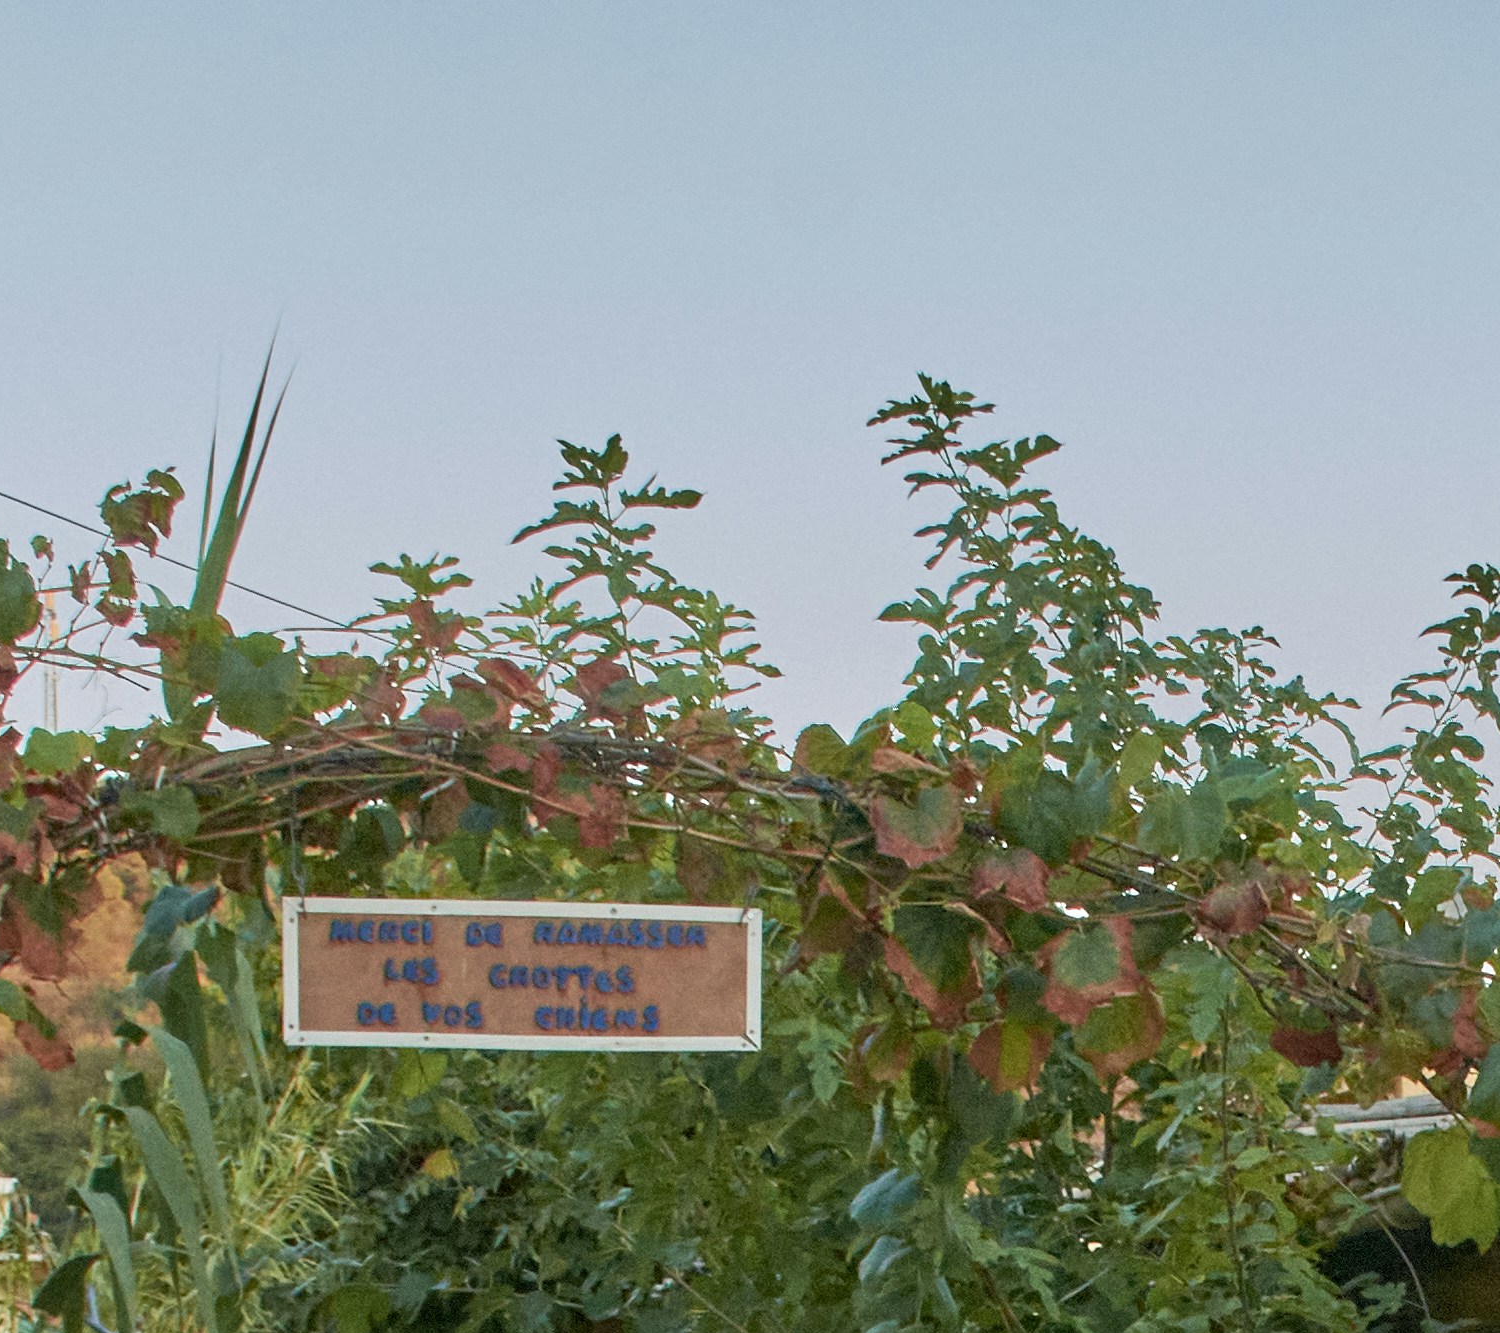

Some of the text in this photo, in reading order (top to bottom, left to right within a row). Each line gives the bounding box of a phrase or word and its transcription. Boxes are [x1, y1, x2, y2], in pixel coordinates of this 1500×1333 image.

[329, 918, 706, 949] MERCI DE RAMASSER
[384, 957, 636, 993] LES CROTTES
[357, 1001, 396, 1026] DE
[422, 1001, 483, 1029] VOS
